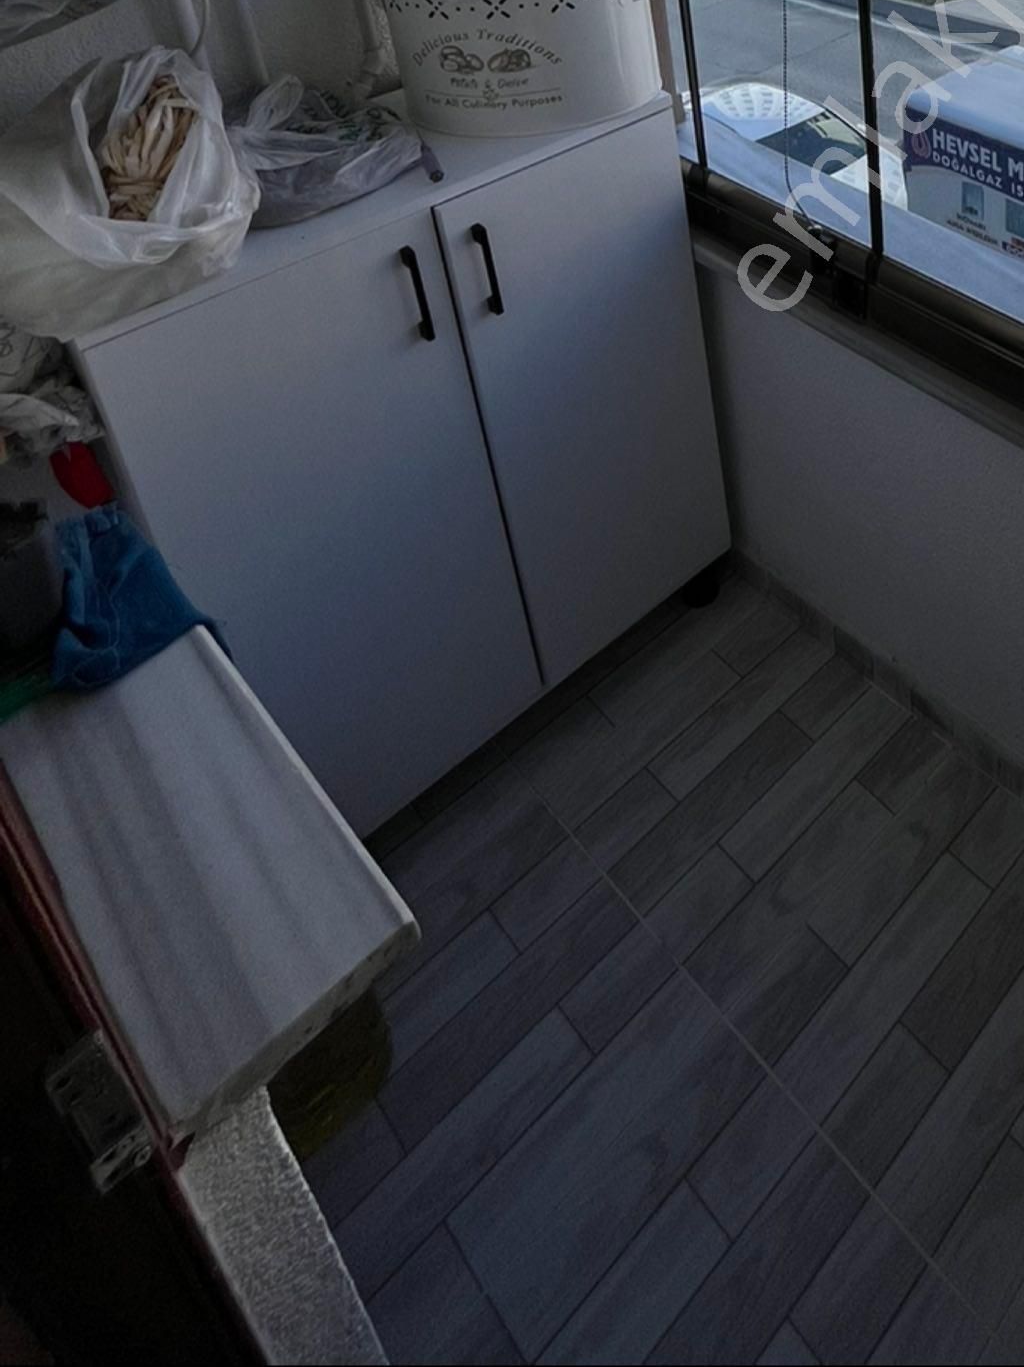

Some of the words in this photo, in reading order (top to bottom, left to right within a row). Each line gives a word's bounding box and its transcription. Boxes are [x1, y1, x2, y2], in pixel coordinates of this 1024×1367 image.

[412, 32, 469, 67] Delicious
[476, 28, 562, 66] Traditions
[511, 94, 563, 109] Purposes
[932, 128, 1003, 173] HEVSEL
[932, 150, 1003, 189] DOĞALGAZ
